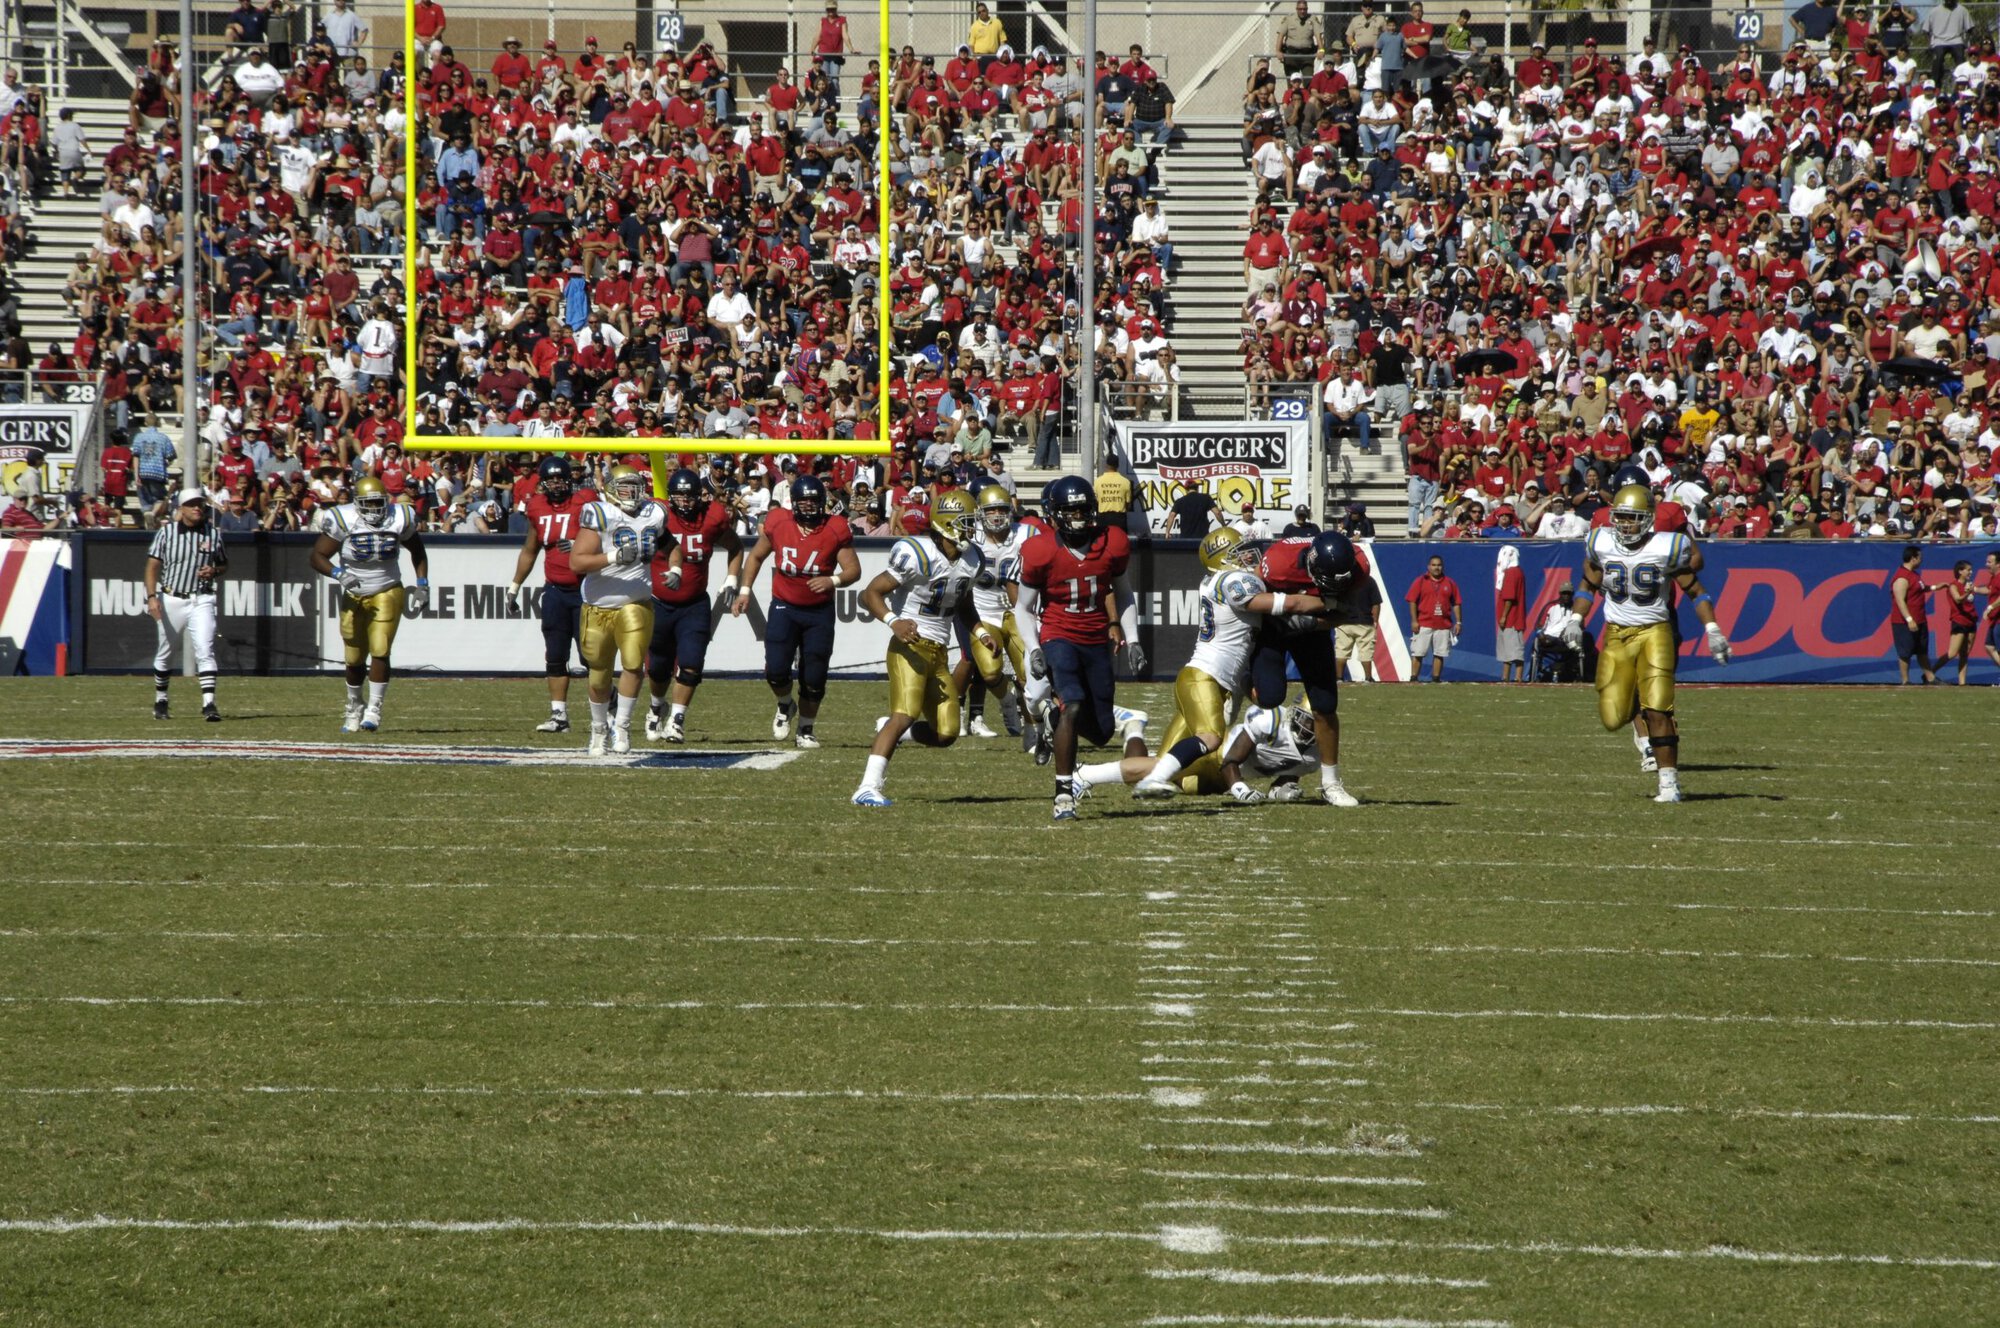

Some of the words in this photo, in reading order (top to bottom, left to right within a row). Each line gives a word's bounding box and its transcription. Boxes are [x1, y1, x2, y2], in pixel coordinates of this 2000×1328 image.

[659, 16, 681, 40] 28
[1738, 15, 1760, 38] 29
[374, 326, 382, 347] 1
[66, 385, 96, 403] 28
[1275, 401, 1304, 418] 29
[1134, 436, 1285, 464] BRUEGGER'S
[1166, 467, 1207, 480] BAKED
[1211, 464, 1250, 475] FRESH
[538, 513, 571, 545] 77
[781, 547, 821, 577] 64
[918, 576, 971, 618] 11
[1064, 574, 1098, 614] 11
[1604, 560, 1661, 606] 39
[224, 580, 305, 617] MILK
